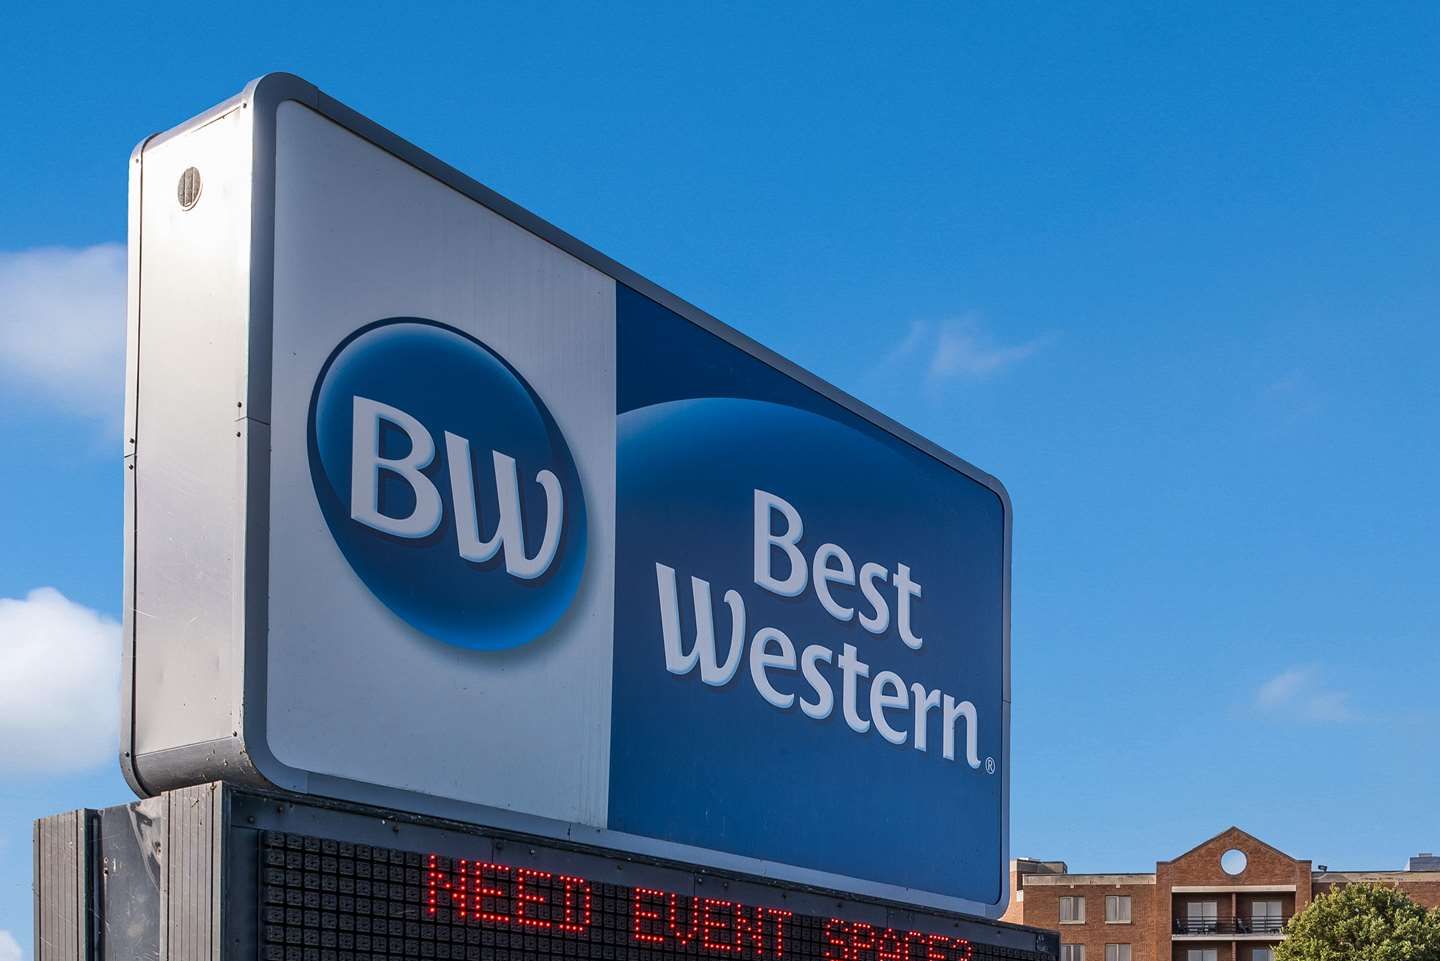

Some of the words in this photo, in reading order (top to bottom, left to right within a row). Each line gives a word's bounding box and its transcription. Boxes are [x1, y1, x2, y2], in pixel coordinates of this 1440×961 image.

[351, 395, 564, 579] BW
[754, 488, 923, 650] Best
[655, 561, 983, 769] Western
[426, 854, 592, 932] NEED
[635, 886, 793, 957] EVENT
